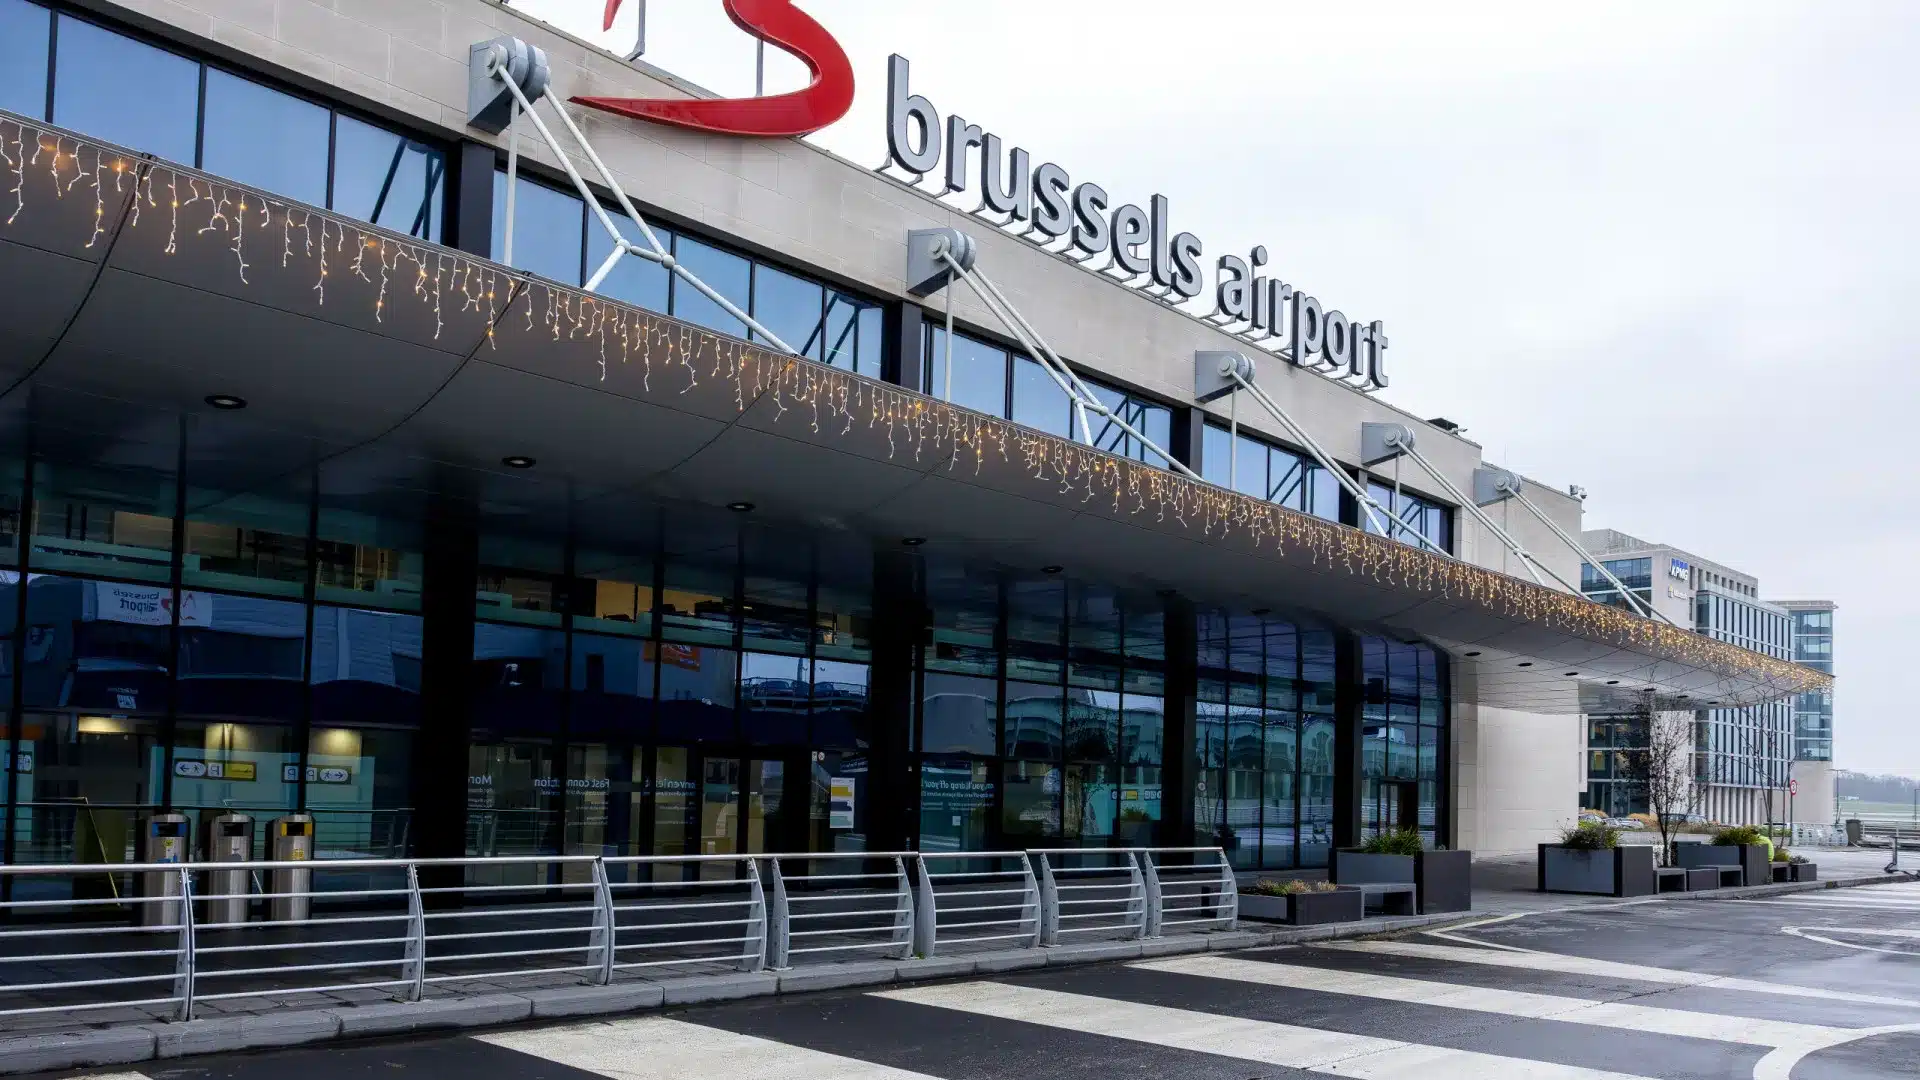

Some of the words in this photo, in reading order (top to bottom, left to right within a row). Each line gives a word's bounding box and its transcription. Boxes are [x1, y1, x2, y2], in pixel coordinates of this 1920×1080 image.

[886, 53, 1202, 298] brussels
[1217, 245, 1390, 388] airport
[1671, 565, 1689, 581] KPMG
